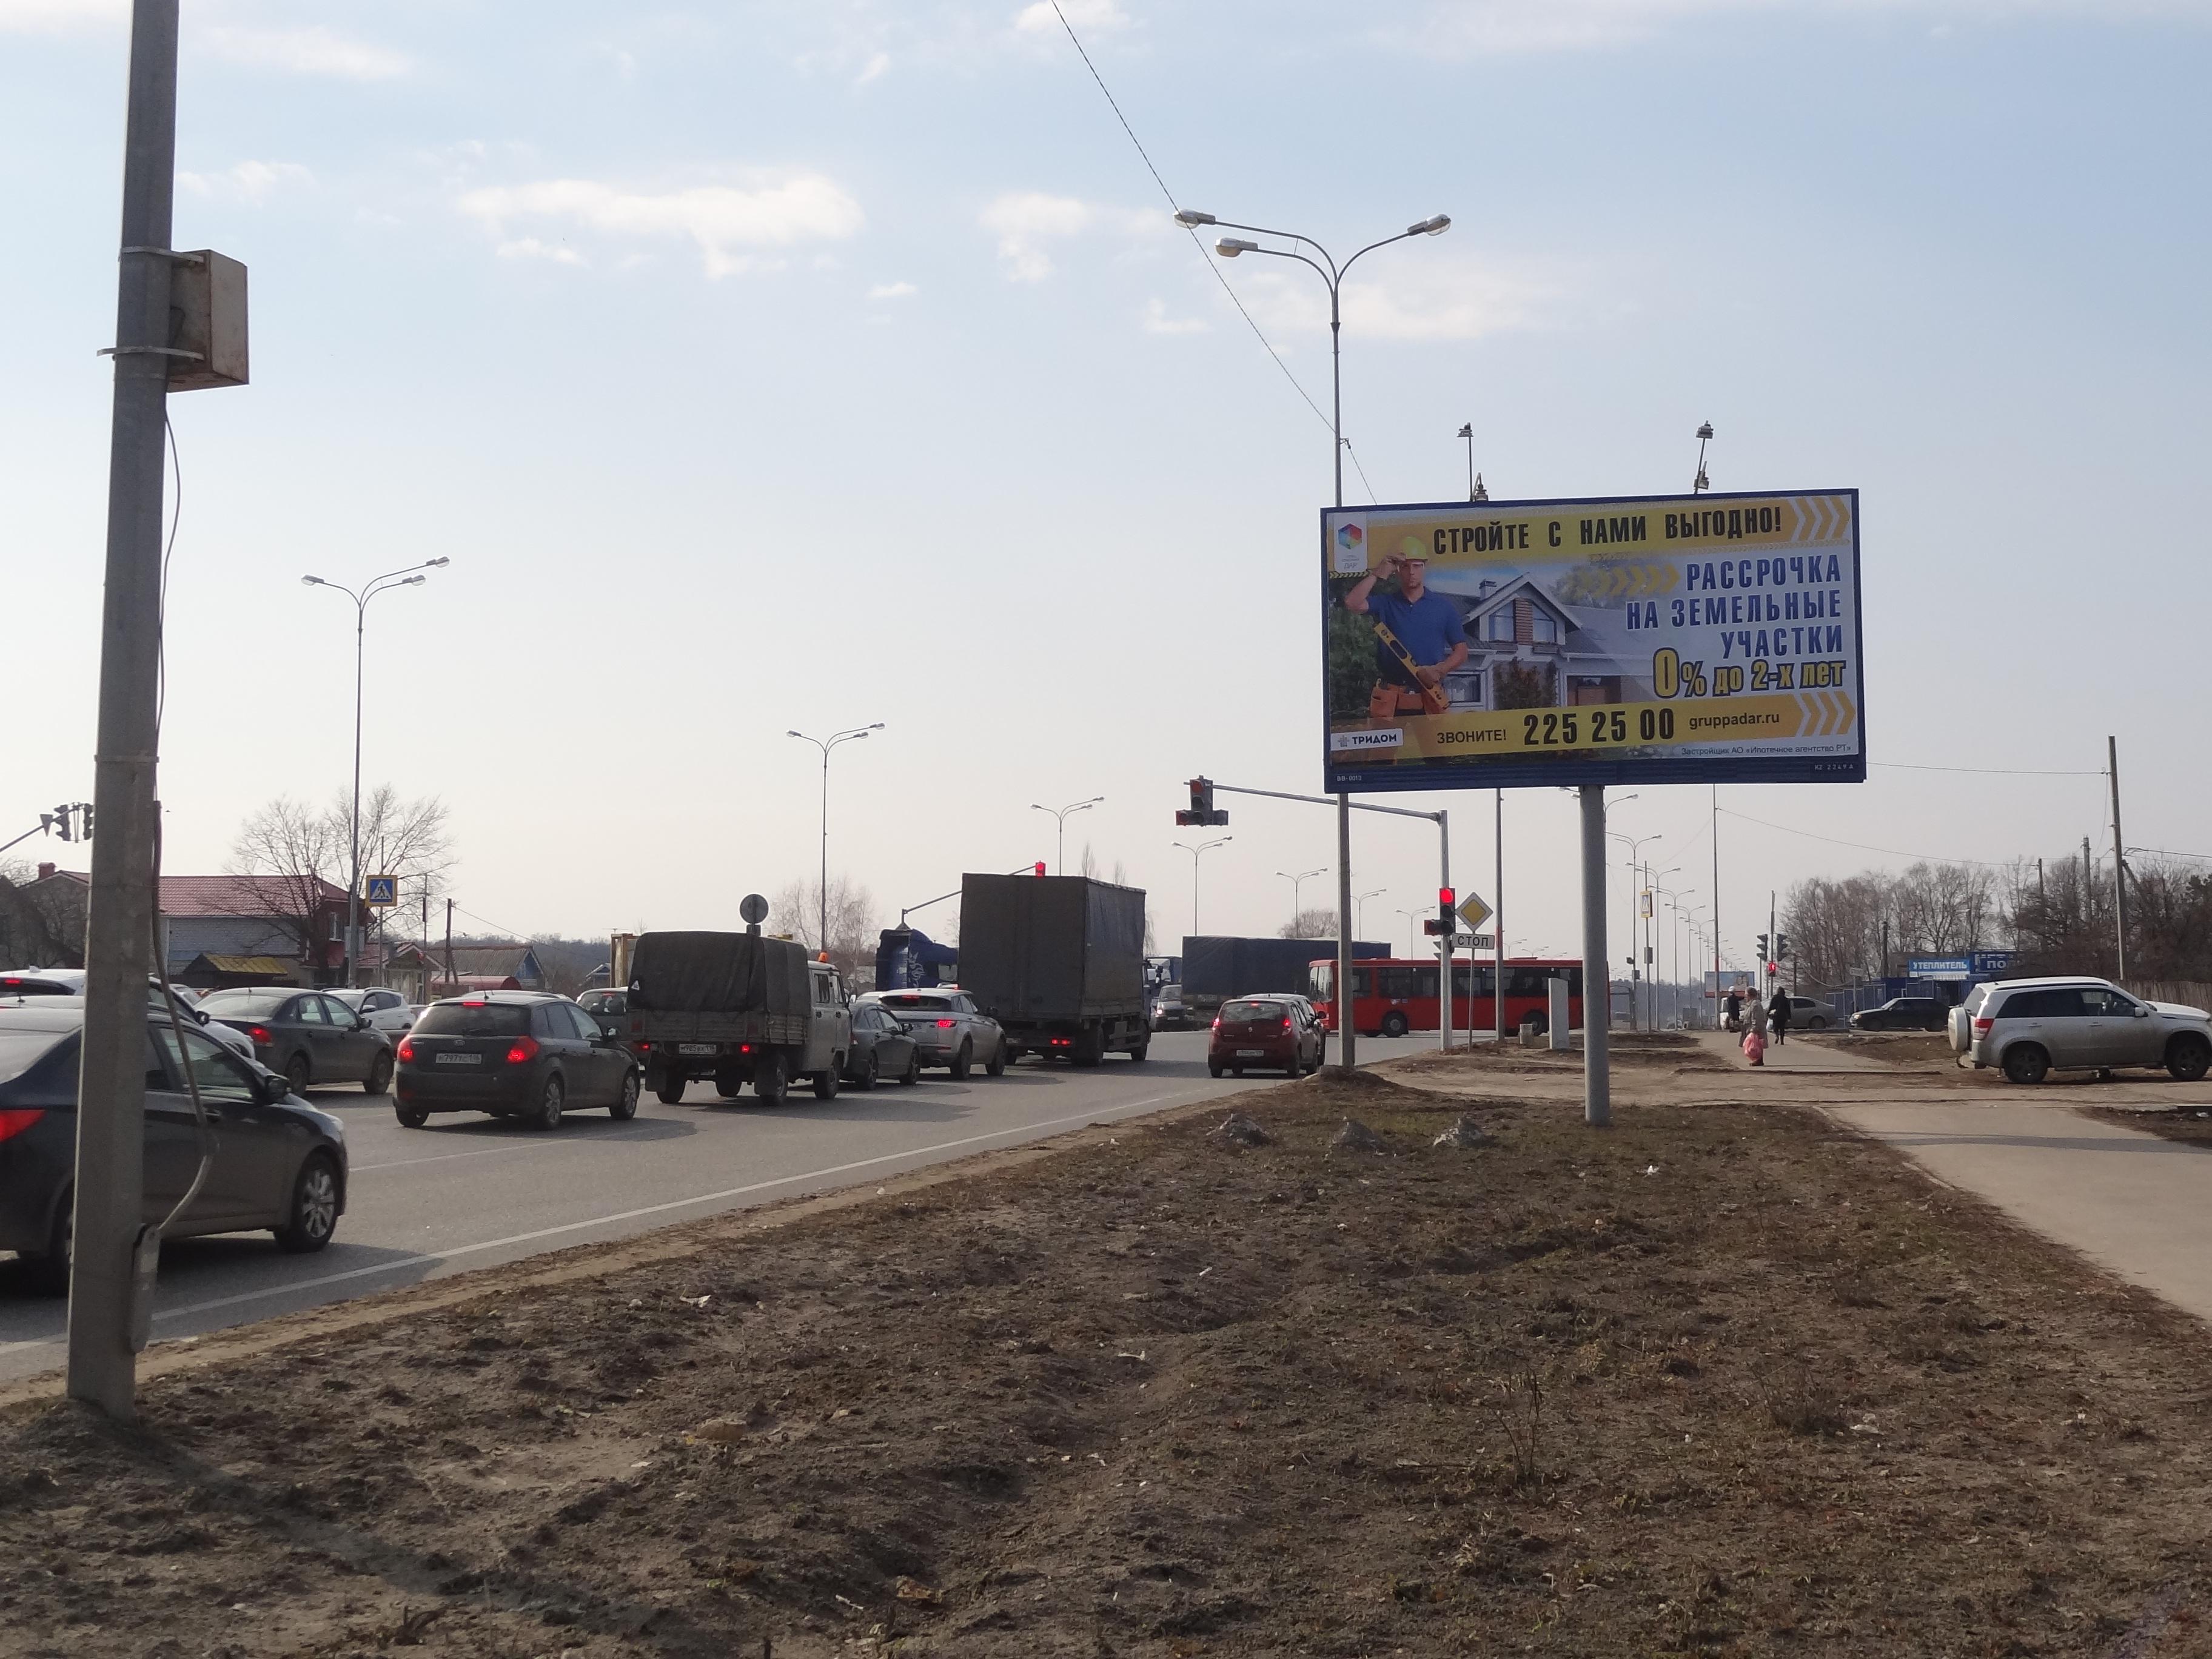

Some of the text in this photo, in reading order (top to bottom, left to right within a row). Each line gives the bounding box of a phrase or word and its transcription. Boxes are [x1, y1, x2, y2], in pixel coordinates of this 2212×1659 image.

[1433, 506, 1781, 554] СТРОЙТЕ С НАМИ ВЫГОДНО!
[1686, 554, 1840, 591] РАССРОЧКА
[1626, 589, 1841, 630] НА ЗЕМЕЛЬНЫЕ
[1721, 625, 1842, 659] УЧАСТКИ
[1652, 647, 1846, 699] 0% до 2-х лет
[1437, 708, 1674, 745] ЗВОНИТЕ! 225 25 00
[1689, 712, 1780, 730] gruppadar.ru
[1352, 734, 1397, 745] ТРИДОМ
[1681, 747, 1729, 756] Застройщик
[1795, 745, 1834, 753] агентство
[1457, 936, 1489, 947] СТОП
[1913, 961, 1968, 970] УТЕПЛИТЕЛЬ
